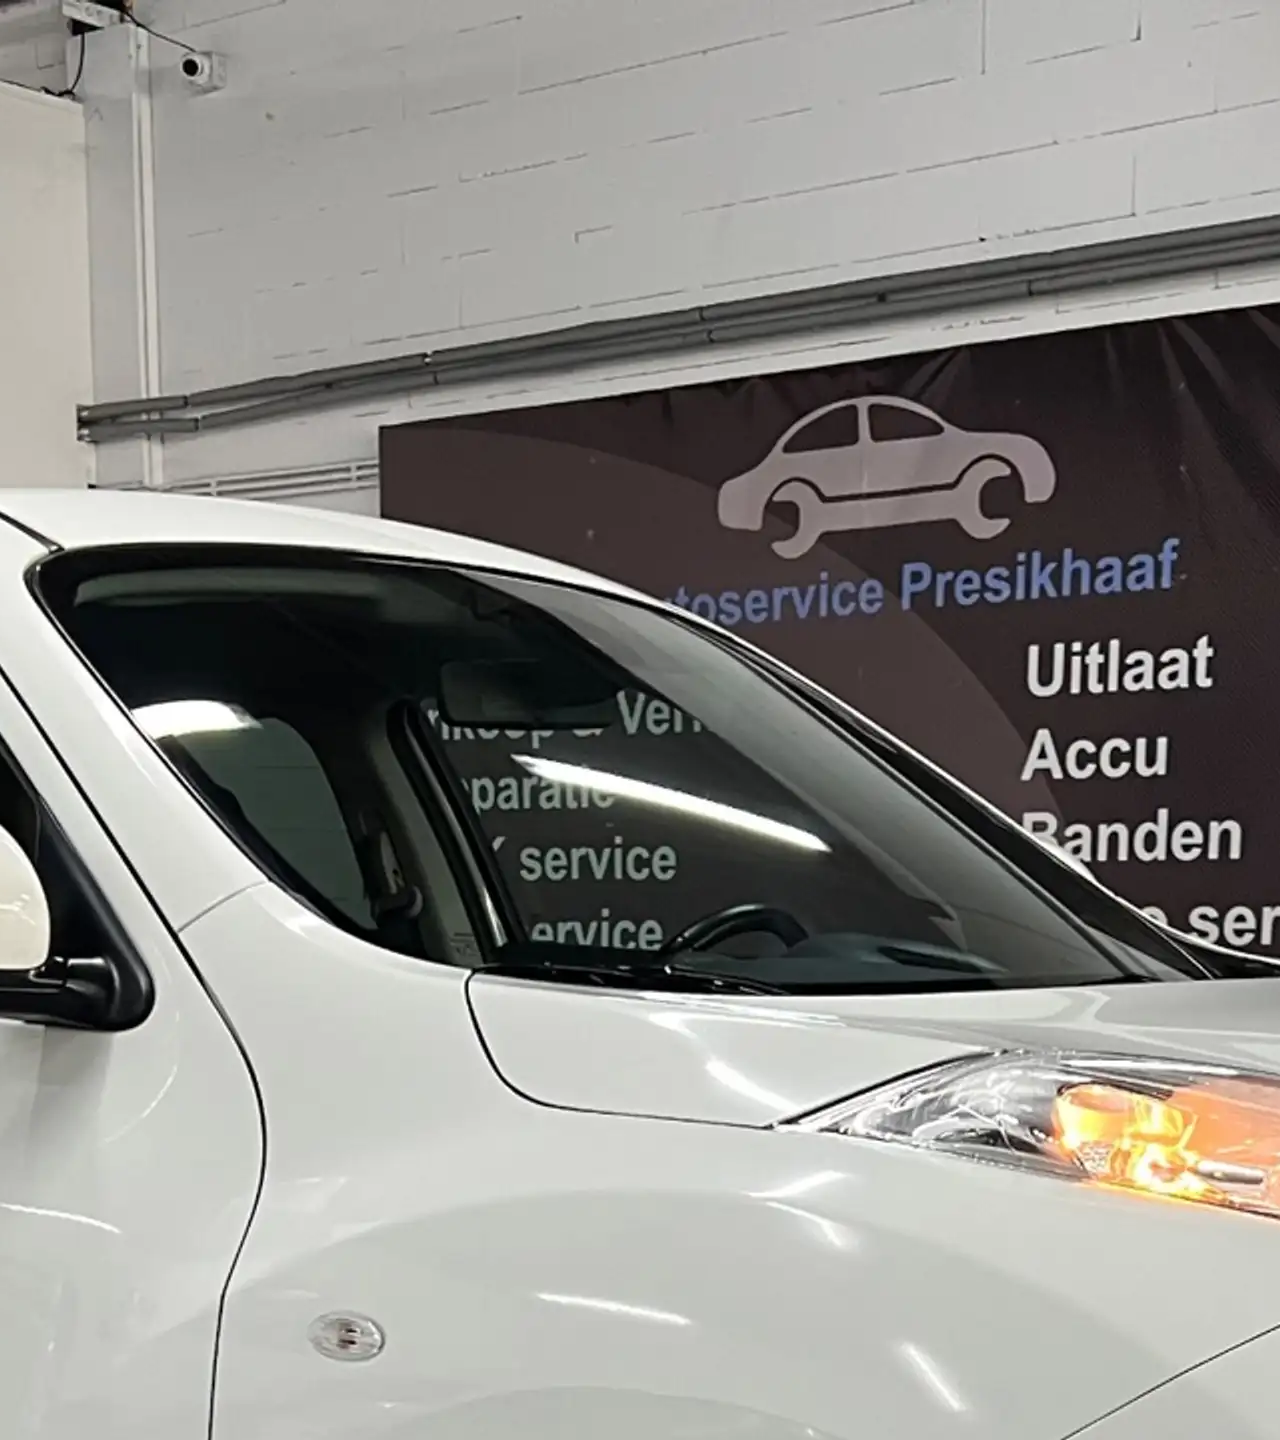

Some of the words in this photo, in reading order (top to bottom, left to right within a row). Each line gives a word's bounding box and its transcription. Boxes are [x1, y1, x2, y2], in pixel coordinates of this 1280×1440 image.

[664, 571, 884, 626] toservice
[901, 537, 1181, 611] Presikhaaf
[1027, 634, 1215, 698] Uitlaat
[1021, 728, 1168, 781] Accu
[519, 835, 678, 882] service
[1022, 808, 1244, 862] Banden
